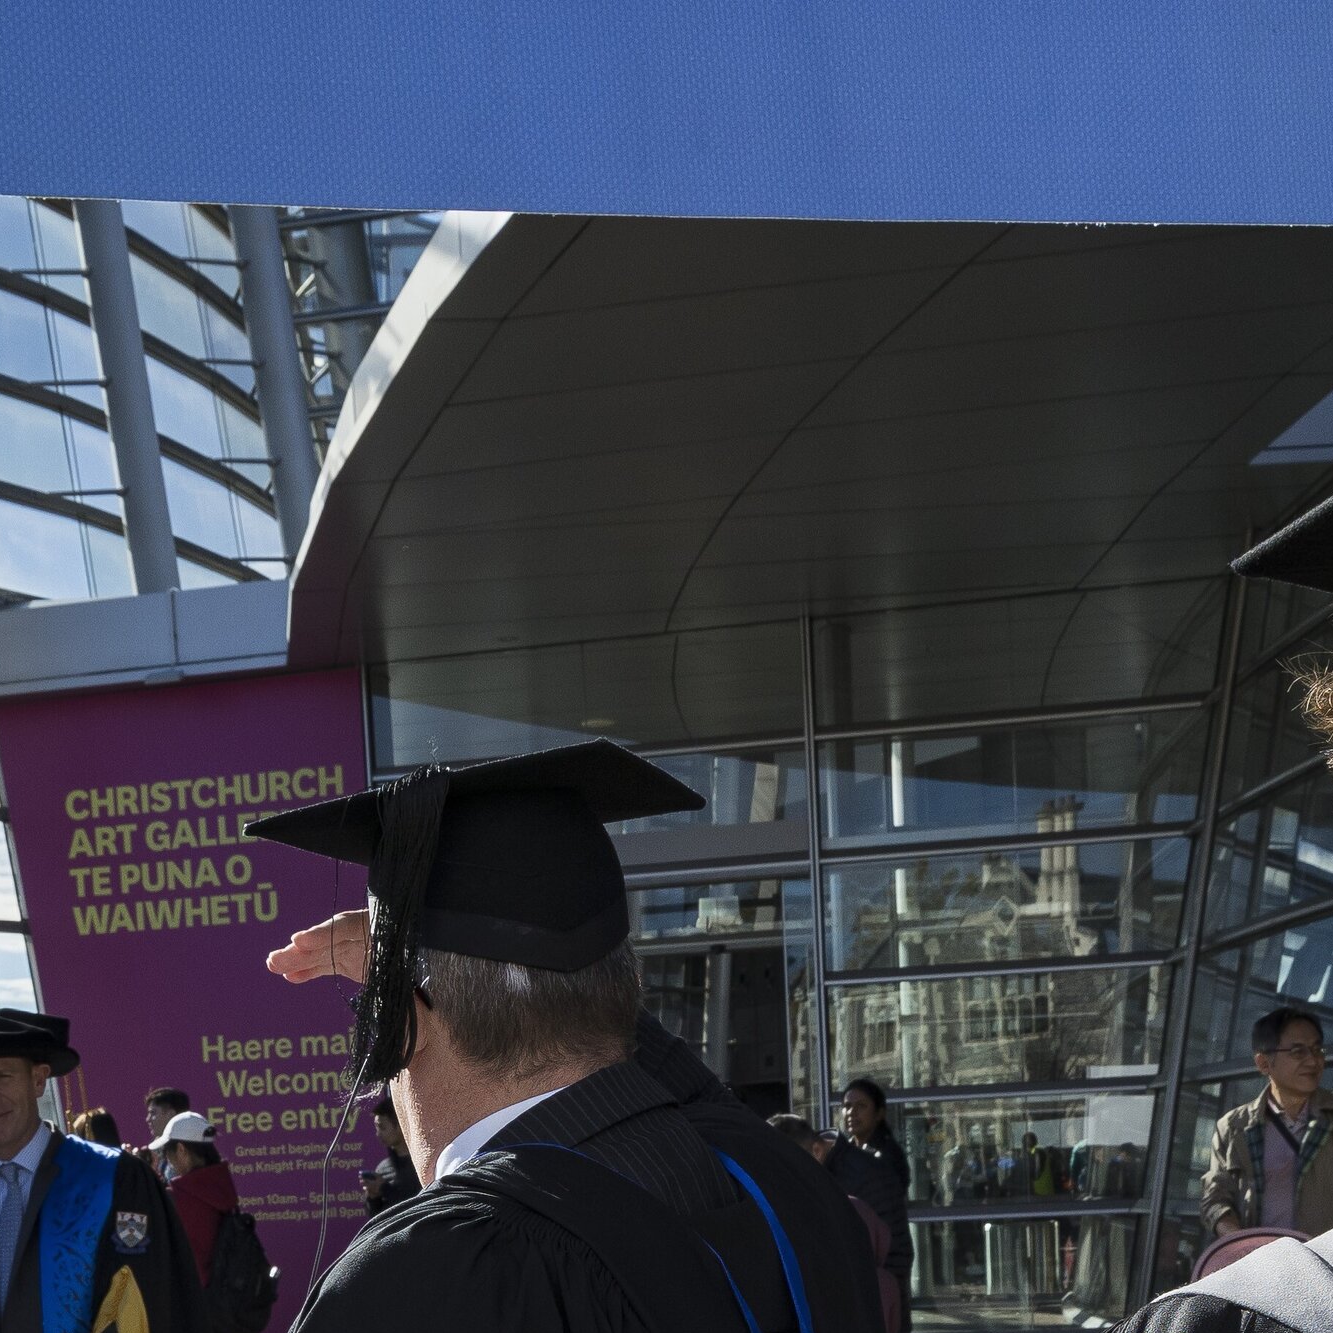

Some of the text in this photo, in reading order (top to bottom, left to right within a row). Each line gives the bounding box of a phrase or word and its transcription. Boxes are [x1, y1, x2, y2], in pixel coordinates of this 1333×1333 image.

[65, 765, 344, 820] CHRISTCHURCH
[68, 810, 280, 859] ART GALLE
[69, 854, 252, 897] TE PUNA O
[72, 882, 278, 936] WAIWHETŪ
[201, 1034, 292, 1063] Haere
[217, 1068, 354, 1098] Welcome
[207, 1103, 361, 1134] Free entry
[235, 1146, 267, 1157] Great
[269, 1144, 286, 1155] art
[288, 1143, 327, 1156] begins
[255, 1161, 294, 1174] Knight
[266, 1193, 299, 1205] 10am
